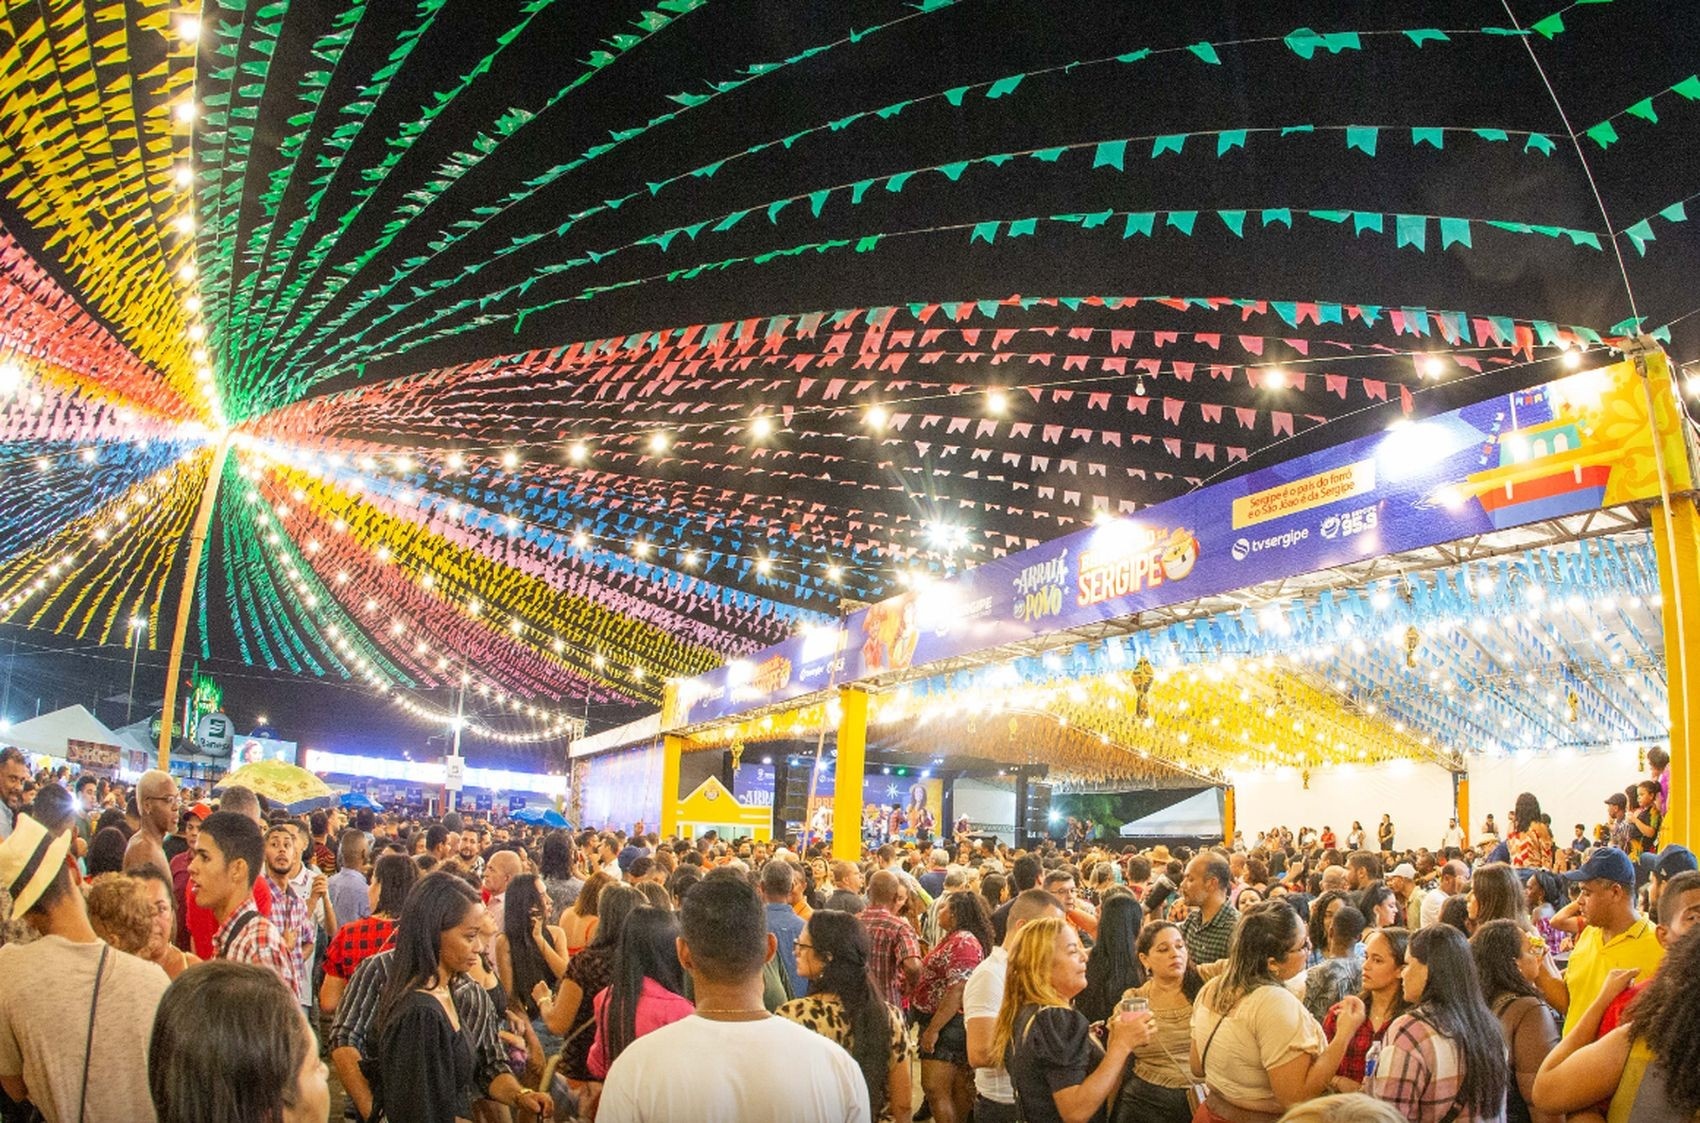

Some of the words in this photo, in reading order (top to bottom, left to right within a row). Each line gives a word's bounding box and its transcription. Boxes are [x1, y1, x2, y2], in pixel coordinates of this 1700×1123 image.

[1248, 511, 1254, 519] e
[1254, 509, 1261, 517] o
[1307, 491, 1319, 502] da
[1320, 481, 1355, 499] Sergipe
[1250, 493, 1282, 508] Sergipe
[1290, 488, 1296, 496] o
[1316, 476, 1329, 489] do
[1012, 547, 1068, 596] ARRAIÁ
[1078, 548, 1163, 606] SERGIPE
[1024, 584, 1063, 623] POVO
